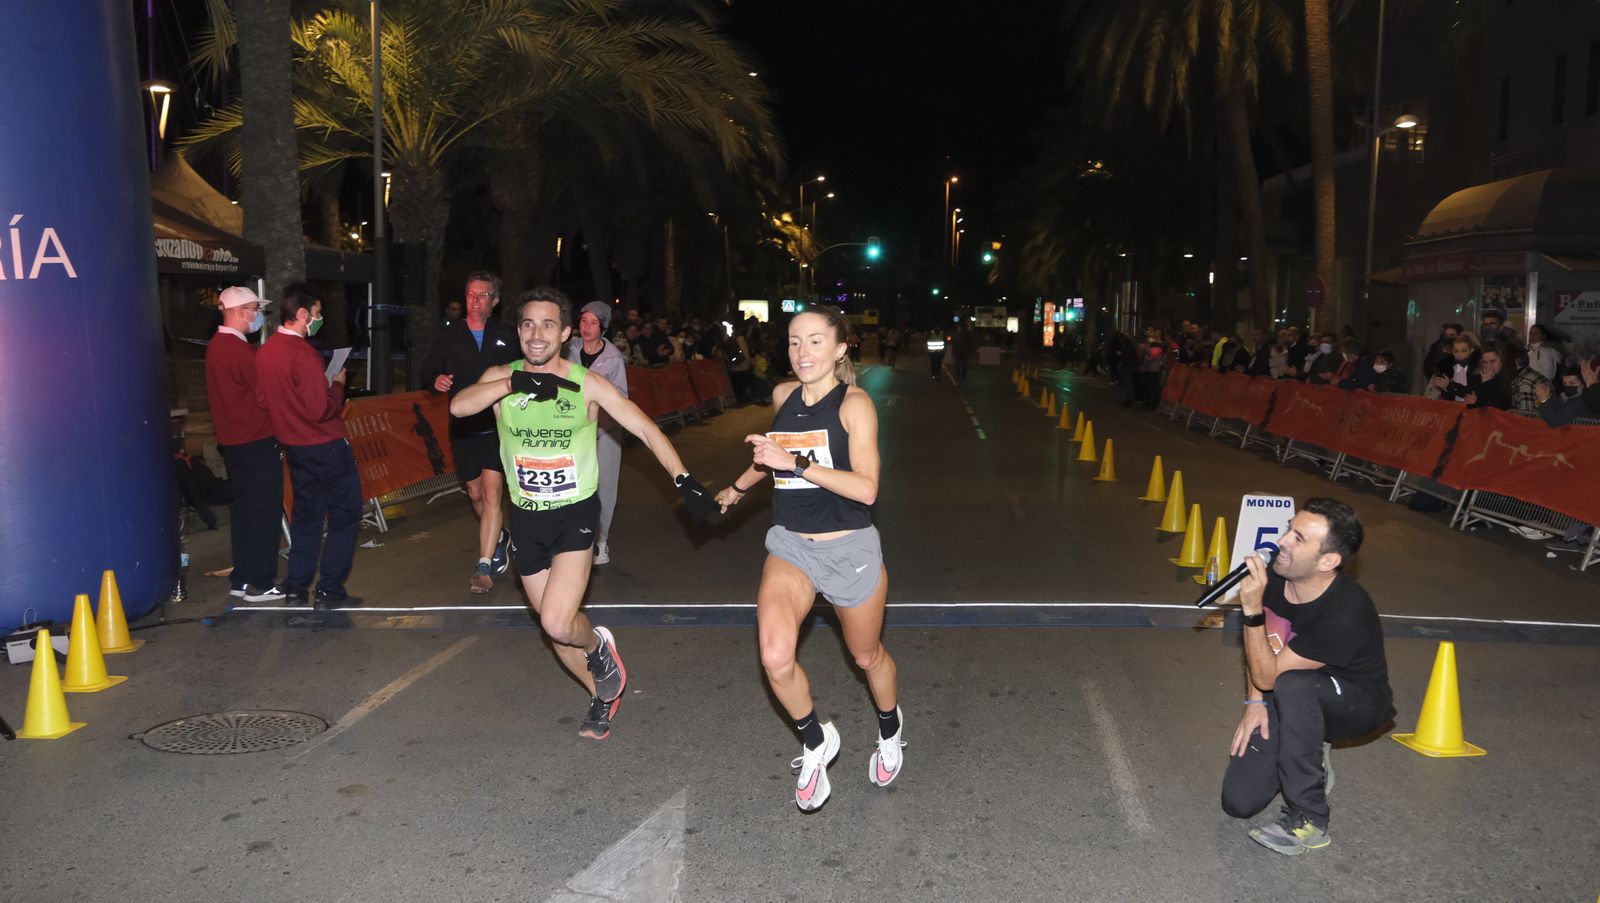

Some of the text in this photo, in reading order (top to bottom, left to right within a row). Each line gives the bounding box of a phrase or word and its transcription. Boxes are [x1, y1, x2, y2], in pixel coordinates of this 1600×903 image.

[510, 427, 572, 438] Universo
[522, 439, 571, 449] Running
[526, 469, 566, 486] 235
[1247, 499, 1291, 508] MONDO
[1254, 527, 1279, 555] 5
